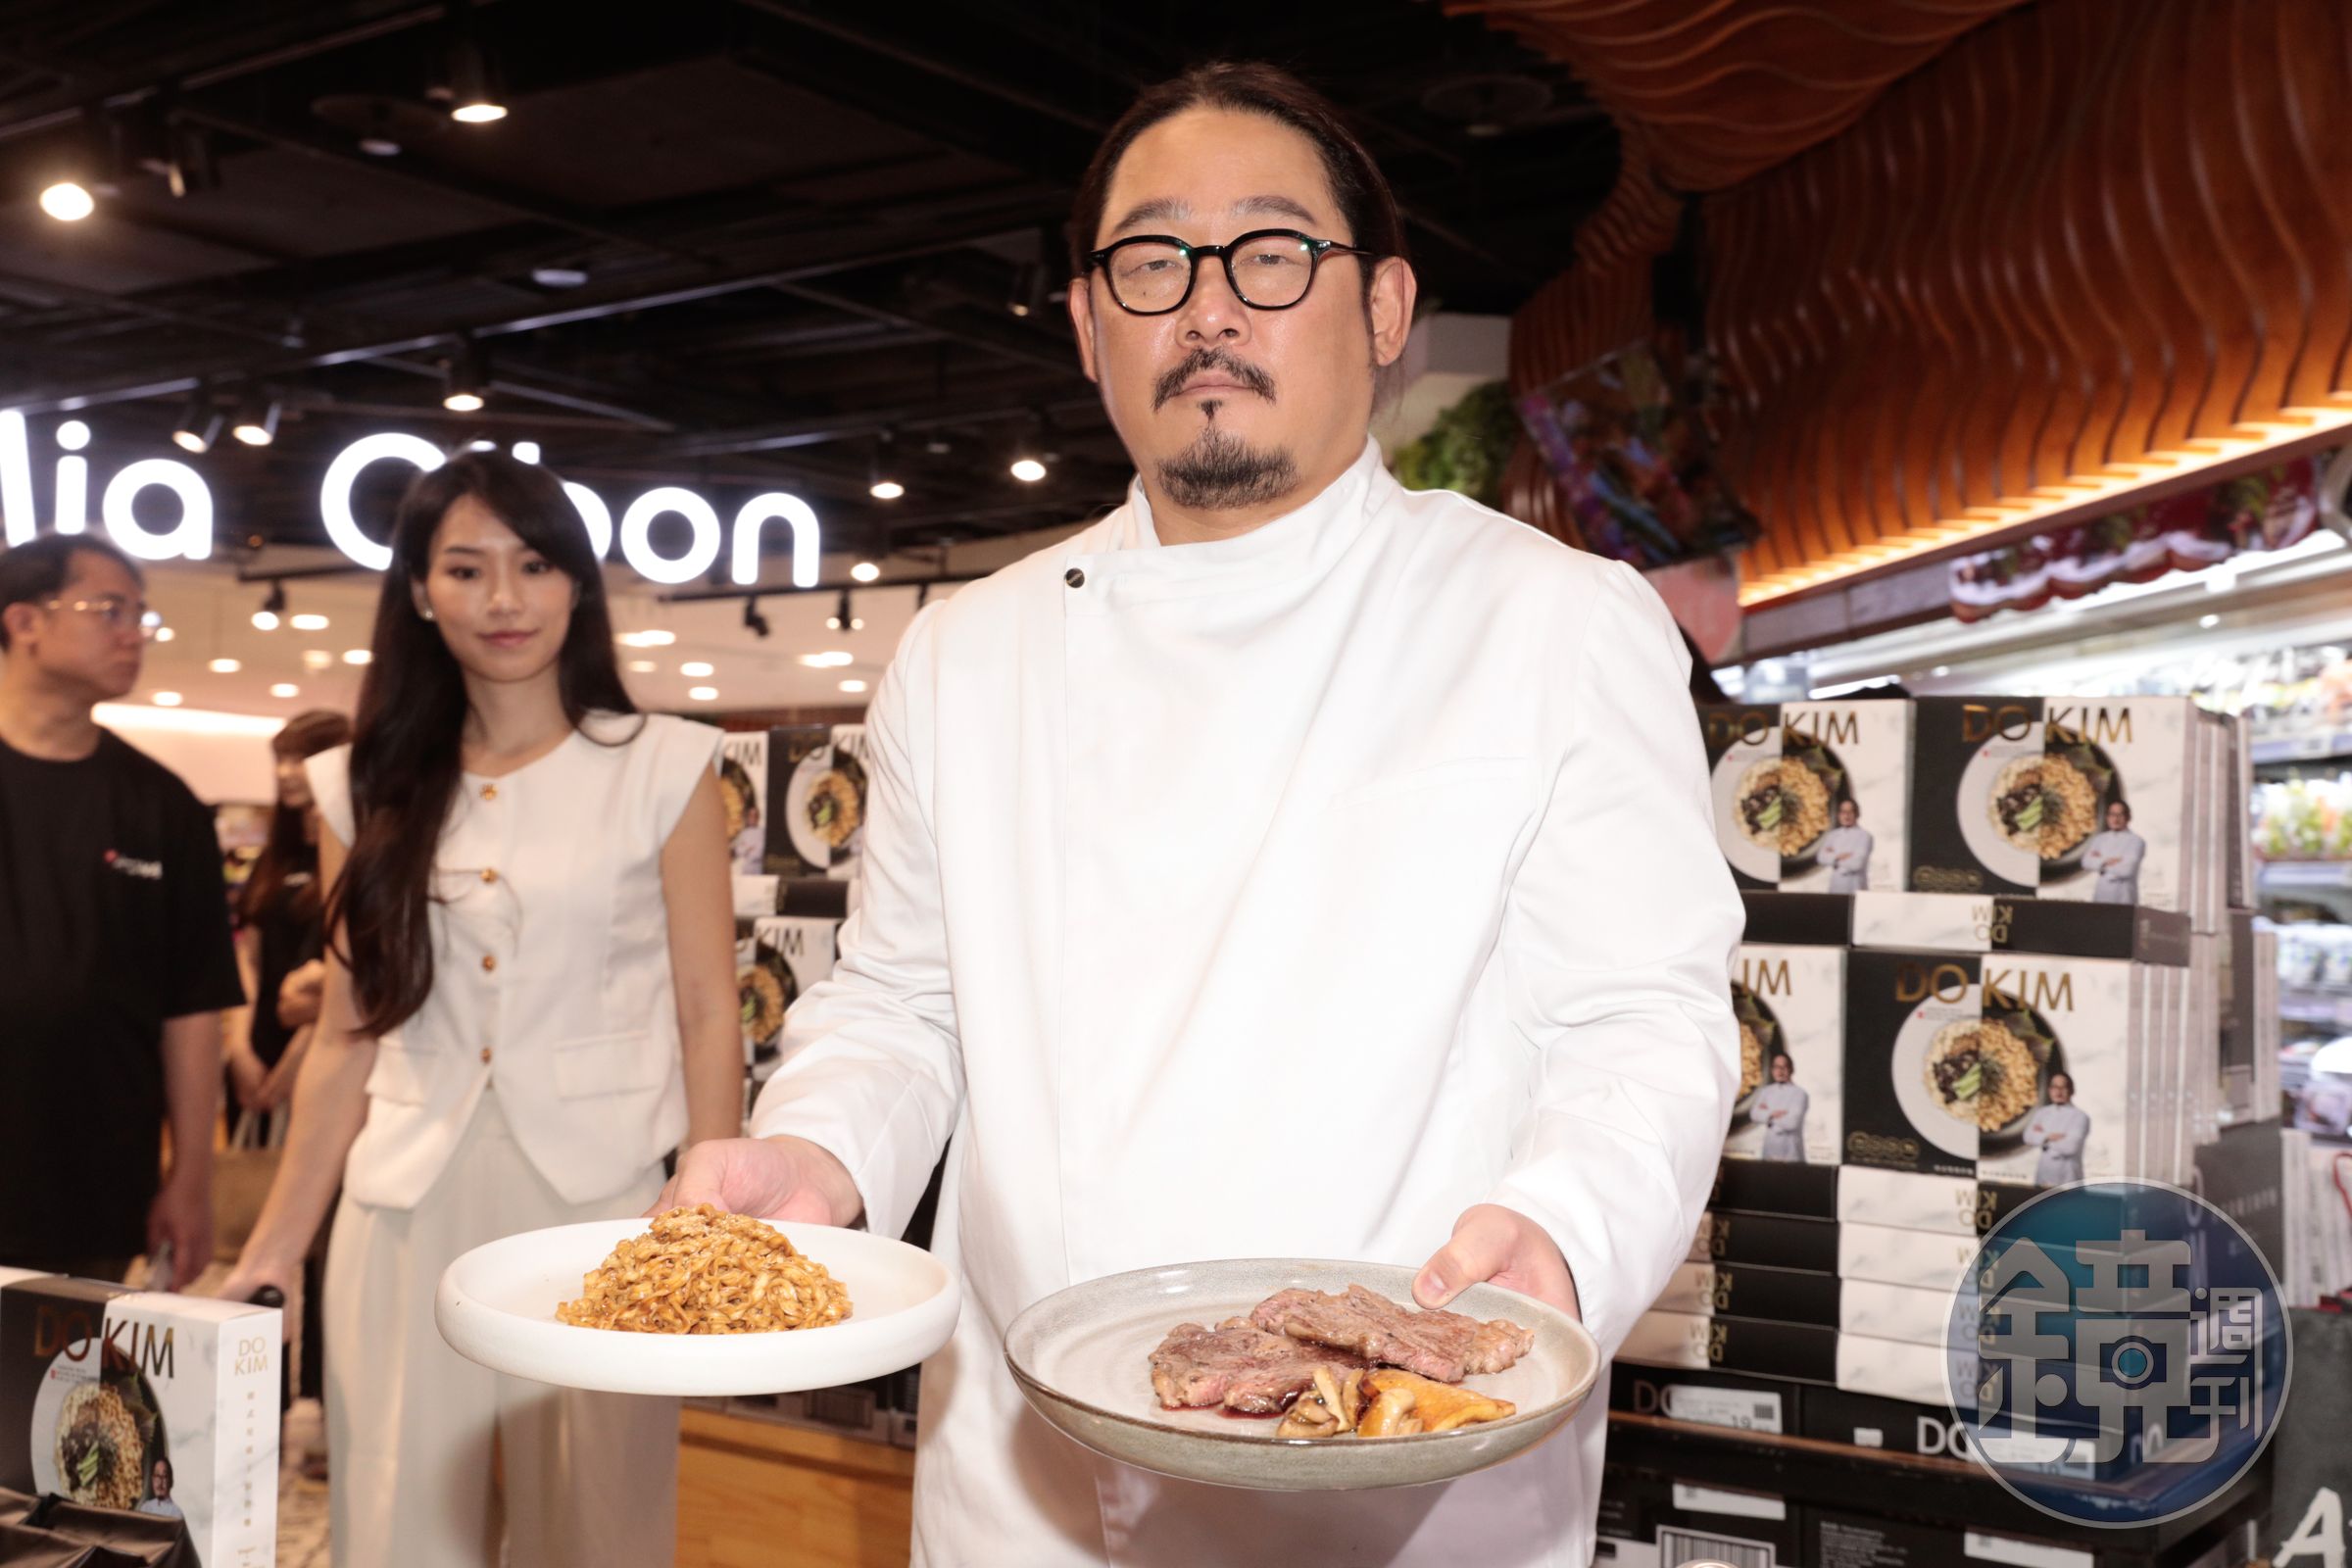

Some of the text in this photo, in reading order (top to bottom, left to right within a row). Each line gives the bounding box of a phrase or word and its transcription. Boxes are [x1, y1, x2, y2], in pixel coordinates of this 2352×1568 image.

[320, 432, 820, 588] Con
[1708, 710, 1859, 747] DO KIM
[1962, 704, 2132, 744] DO KIM
[755, 925, 805, 958] KIM
[1740, 958, 1793, 998] IM
[1894, 961, 2075, 1012] DO KIM
[33, 1304, 175, 1380] DO KIM
[237, 1336, 267, 1357] DO
[234, 1355, 269, 1377] KIM
